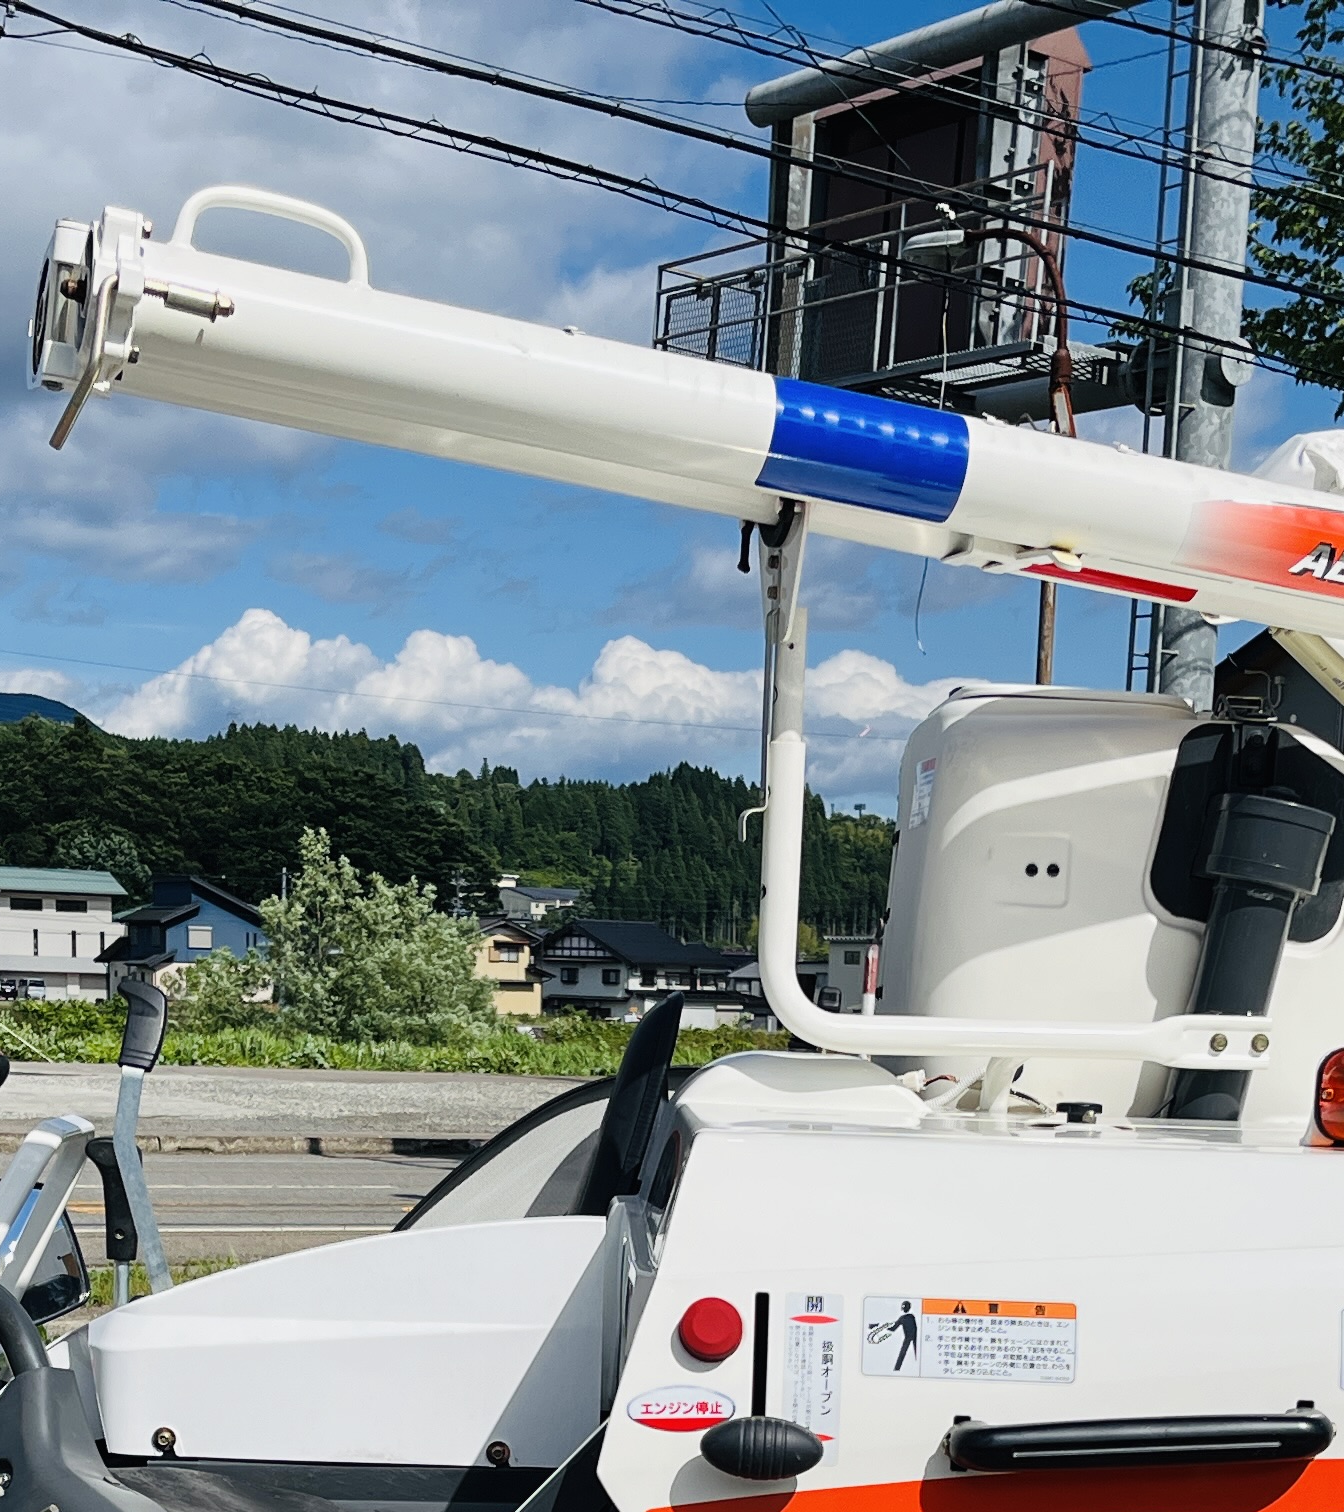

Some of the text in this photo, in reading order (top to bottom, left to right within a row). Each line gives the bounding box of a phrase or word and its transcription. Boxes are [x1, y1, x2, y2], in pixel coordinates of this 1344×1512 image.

[806, 1296, 823, 1313] 開
[640, 1401, 723, 1415] エンジン停止
